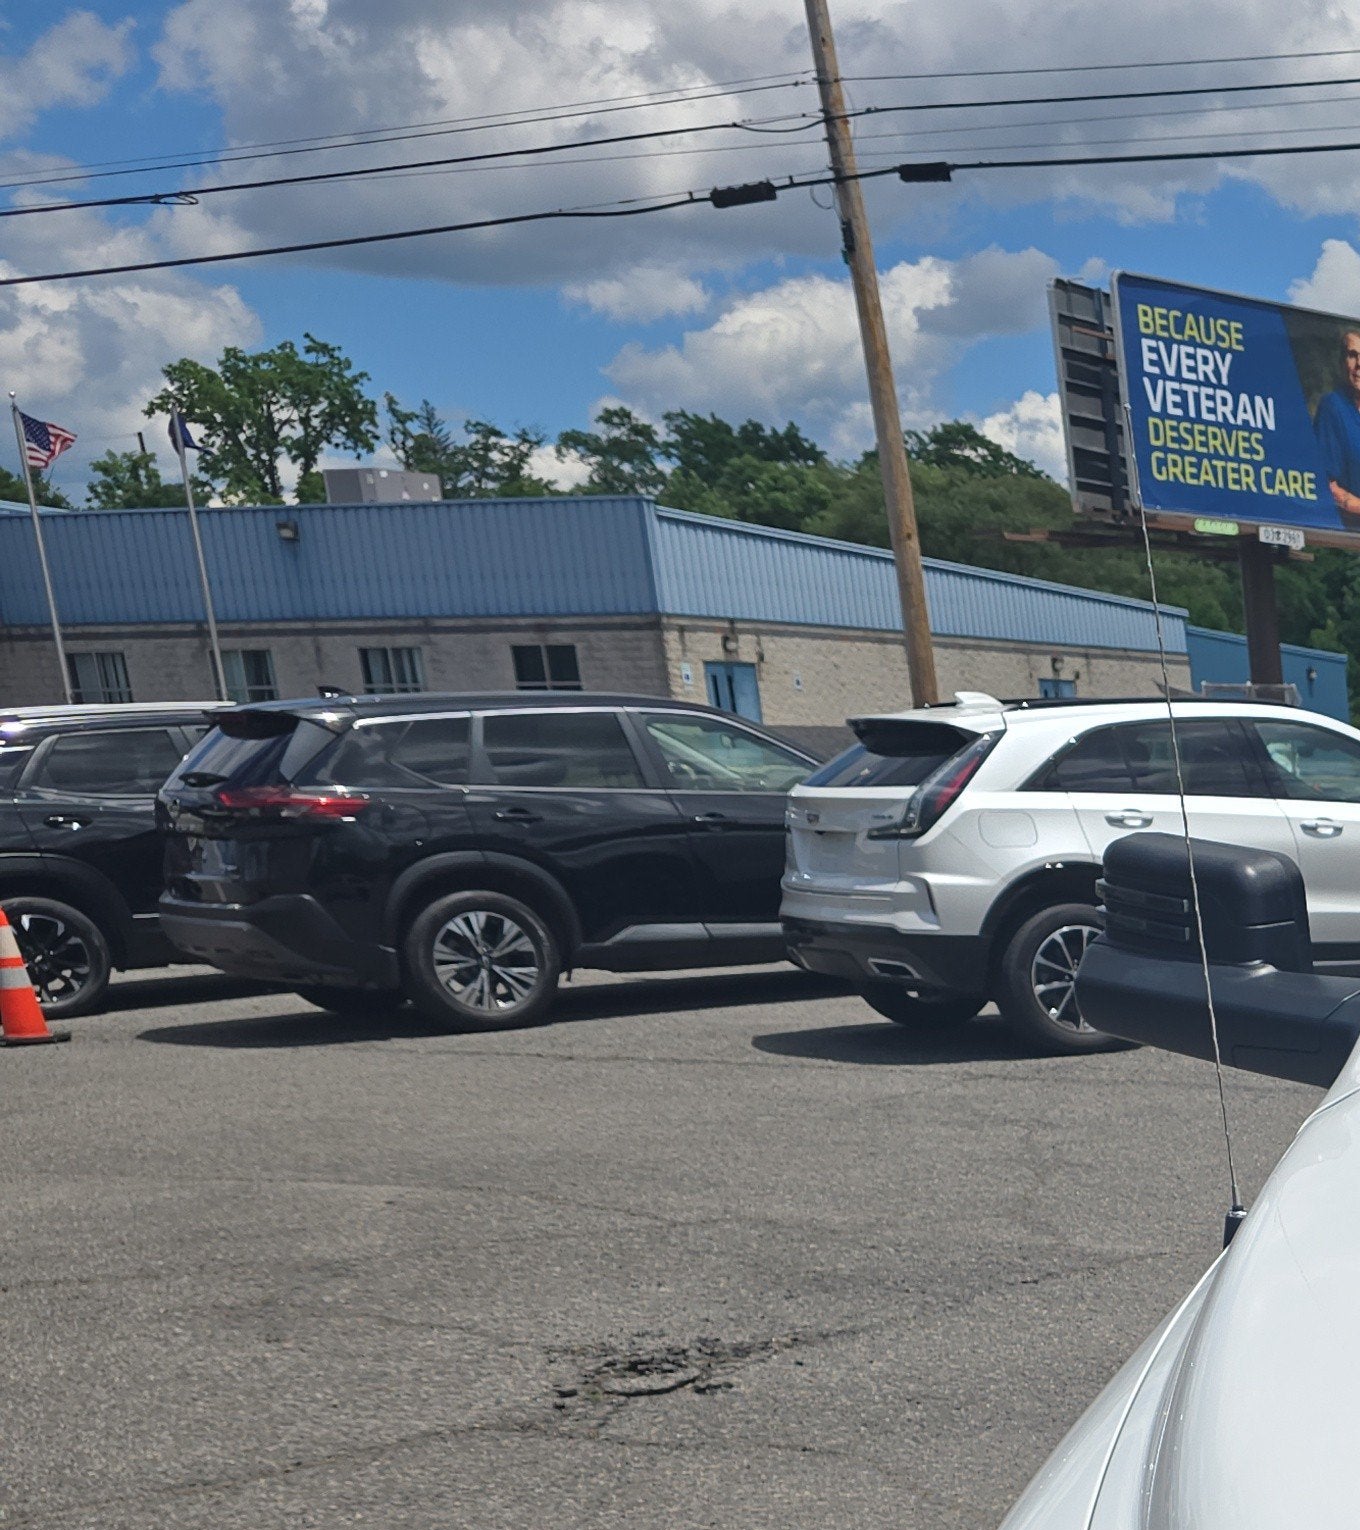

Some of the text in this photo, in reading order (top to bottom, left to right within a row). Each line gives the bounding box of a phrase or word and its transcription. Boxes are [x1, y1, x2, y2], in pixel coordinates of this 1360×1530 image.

[1137, 303, 1245, 352] BECAUSE
[1141, 337, 1233, 386] EVERY
[1142, 376, 1276, 431] VETERAN
[1147, 416, 1265, 461] DESERVES
[1151, 450, 1318, 501] GREATER CARE
